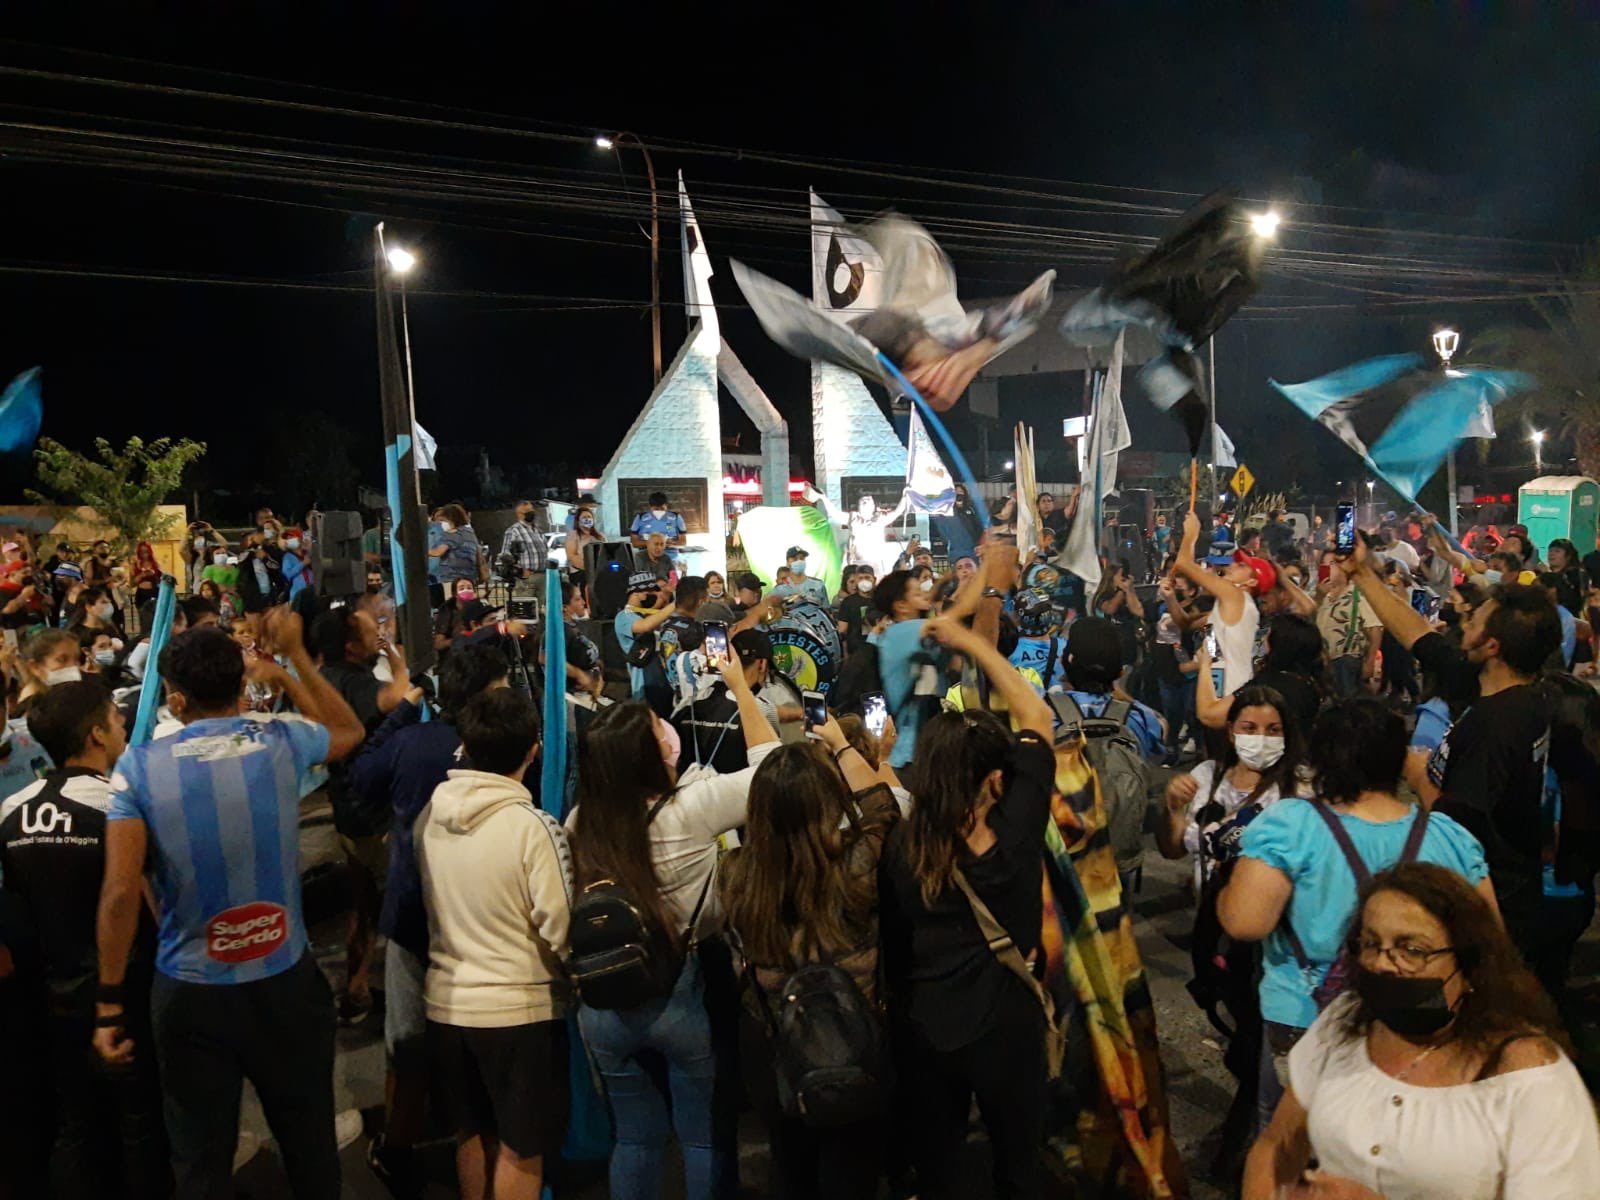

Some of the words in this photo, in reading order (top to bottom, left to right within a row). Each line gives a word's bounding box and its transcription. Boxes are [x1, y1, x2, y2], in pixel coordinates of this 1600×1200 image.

[768, 633, 829, 666] ELESTES
[213, 912, 282, 935] Super
[212, 929, 282, 951] Cerdo
